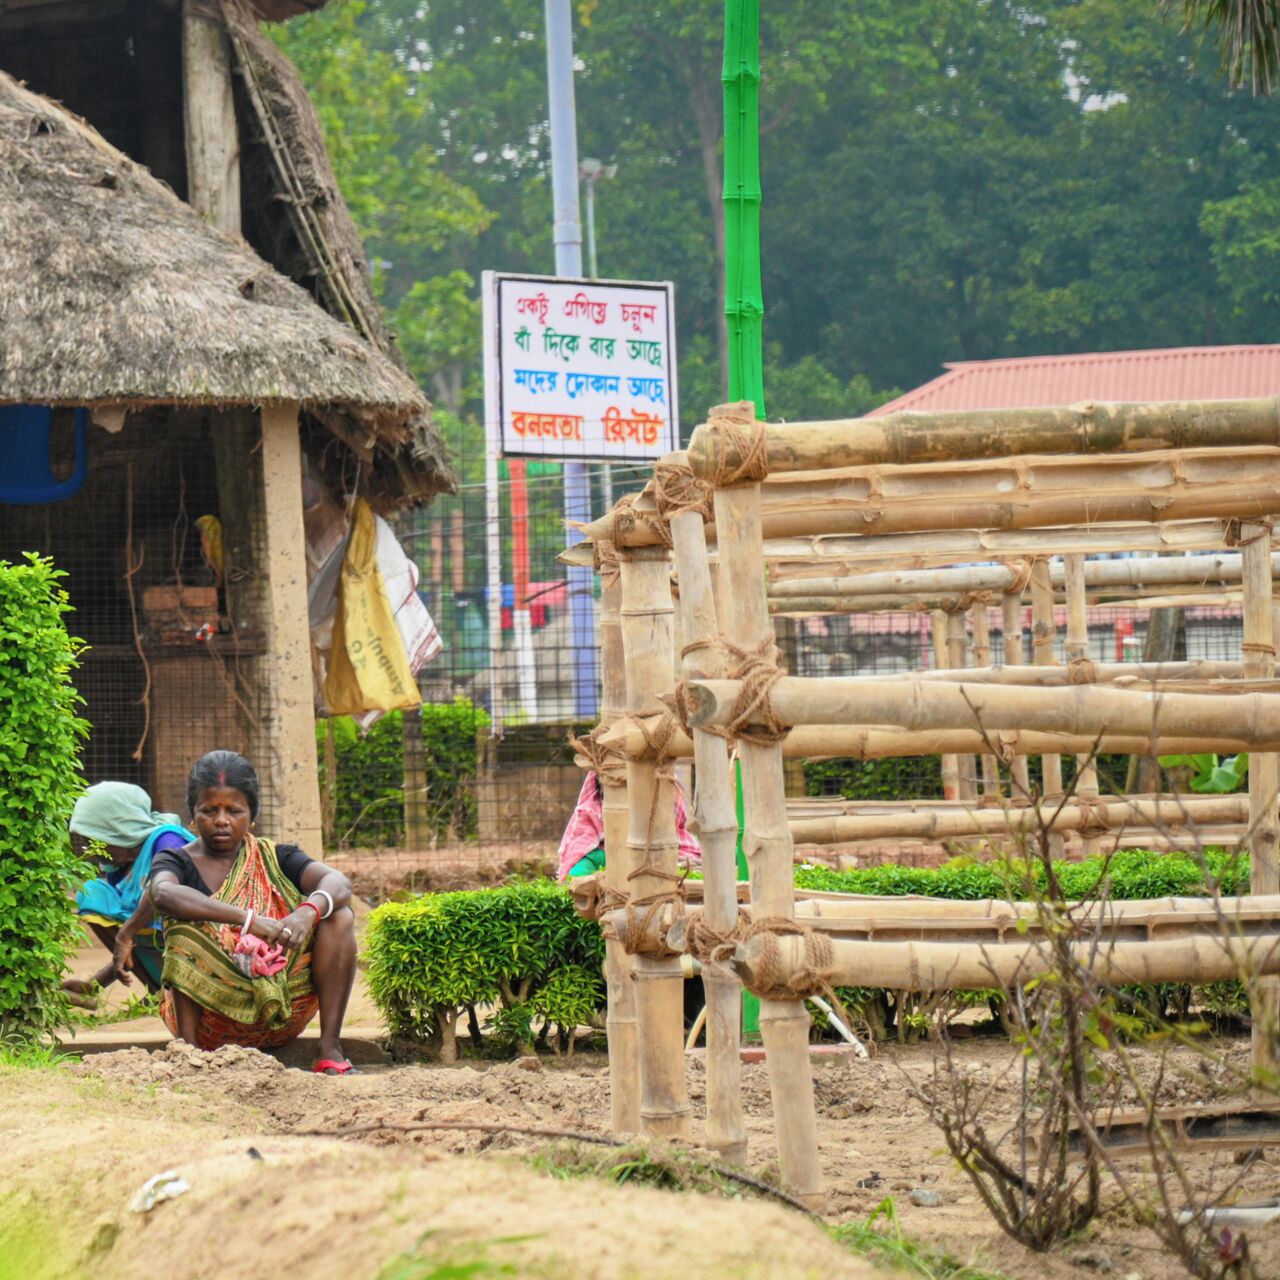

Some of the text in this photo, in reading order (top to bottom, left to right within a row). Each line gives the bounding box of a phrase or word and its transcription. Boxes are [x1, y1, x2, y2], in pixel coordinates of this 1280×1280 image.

[543, 327, 580, 361] দিকে
[590, 337, 616, 360] বার
[626, 339, 664, 369] আছে
[513, 368, 559, 395] মদের
[566, 371, 622, 400] দোকান
[511, 411, 585, 442] বনলতা
